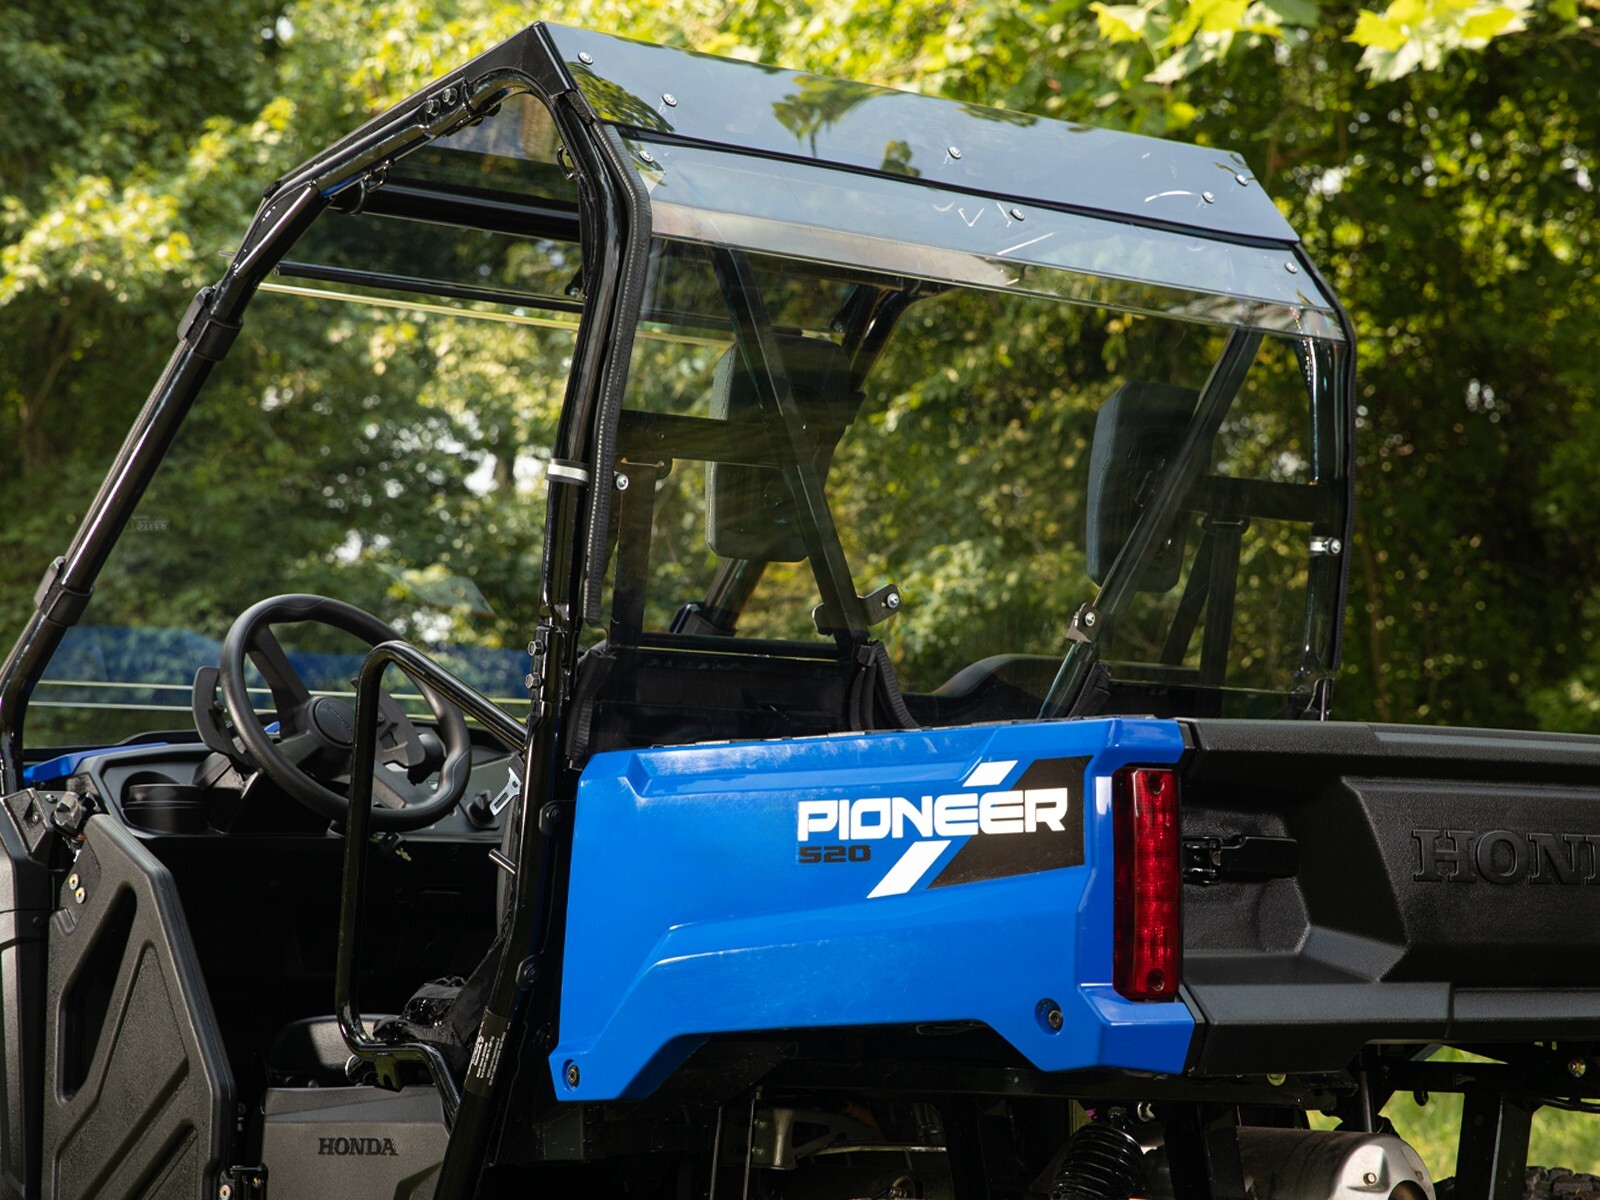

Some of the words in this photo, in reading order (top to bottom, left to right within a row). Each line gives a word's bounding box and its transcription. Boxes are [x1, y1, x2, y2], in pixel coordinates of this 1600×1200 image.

[798, 787, 1068, 841] PIONEER
[799, 845, 871, 864] 520
[318, 1136, 399, 1156] HONDA
